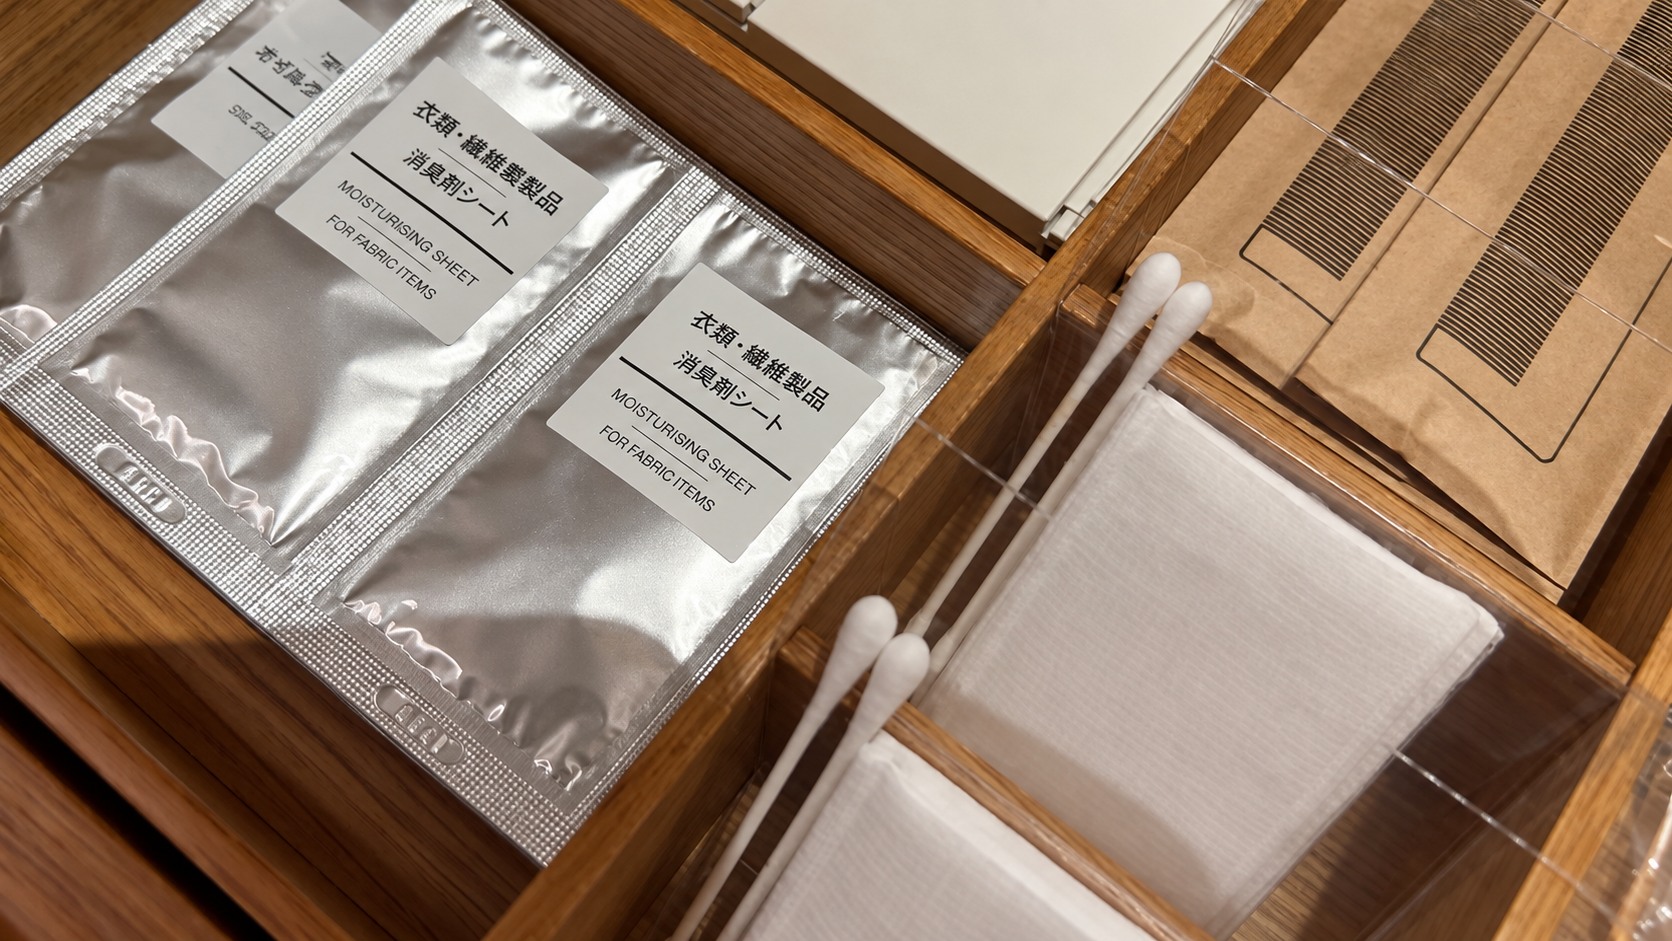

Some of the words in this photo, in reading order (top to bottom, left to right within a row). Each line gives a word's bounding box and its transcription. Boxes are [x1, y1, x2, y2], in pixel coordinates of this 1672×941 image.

[403, 148, 509, 227] 消臭剤シート
[326, 215, 356, 239] FOR
[352, 234, 399, 270] FABRIC
[396, 266, 437, 300] ITEMS
[338, 180, 434, 252] MOISTURISING
[432, 250, 480, 287] SHEET
[673, 351, 783, 431] 消臭剤シート
[599, 425, 630, 450] FOR
[627, 444, 676, 482] FABRIC
[673, 477, 716, 512] ITEMS
[611, 388, 710, 462] MOISTURISING
[709, 458, 757, 496] SHEET
